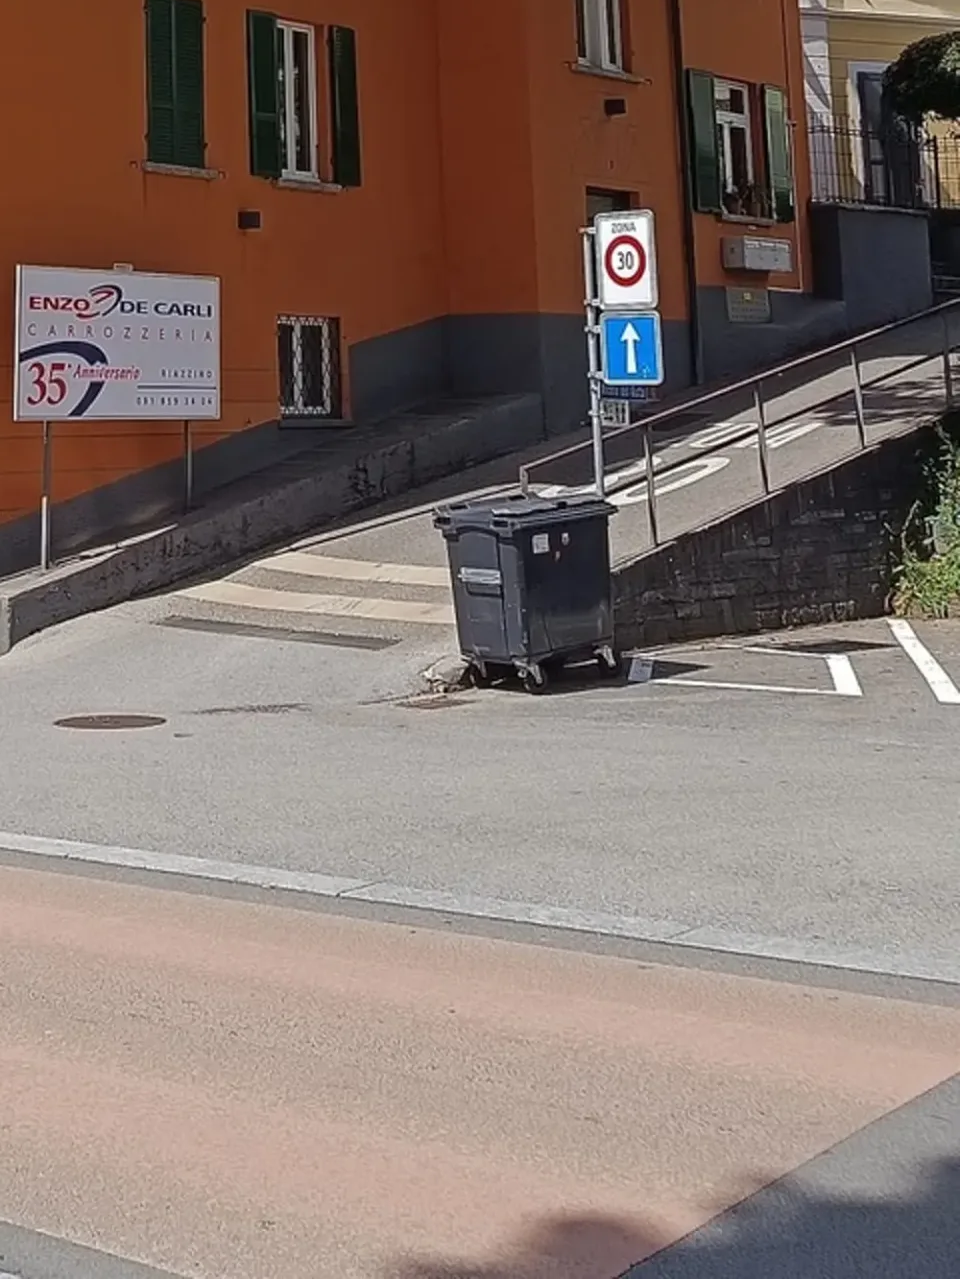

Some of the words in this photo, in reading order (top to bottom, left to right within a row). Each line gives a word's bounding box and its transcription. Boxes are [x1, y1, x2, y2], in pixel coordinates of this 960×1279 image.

[611, 222, 637, 234] ZONA
[617, 251, 635, 270] 30
[29, 296, 91, 312] ENZO
[119, 301, 148, 315] DE
[153, 303, 213, 318] CARLI
[27, 324, 213, 342] CARROZZERIA
